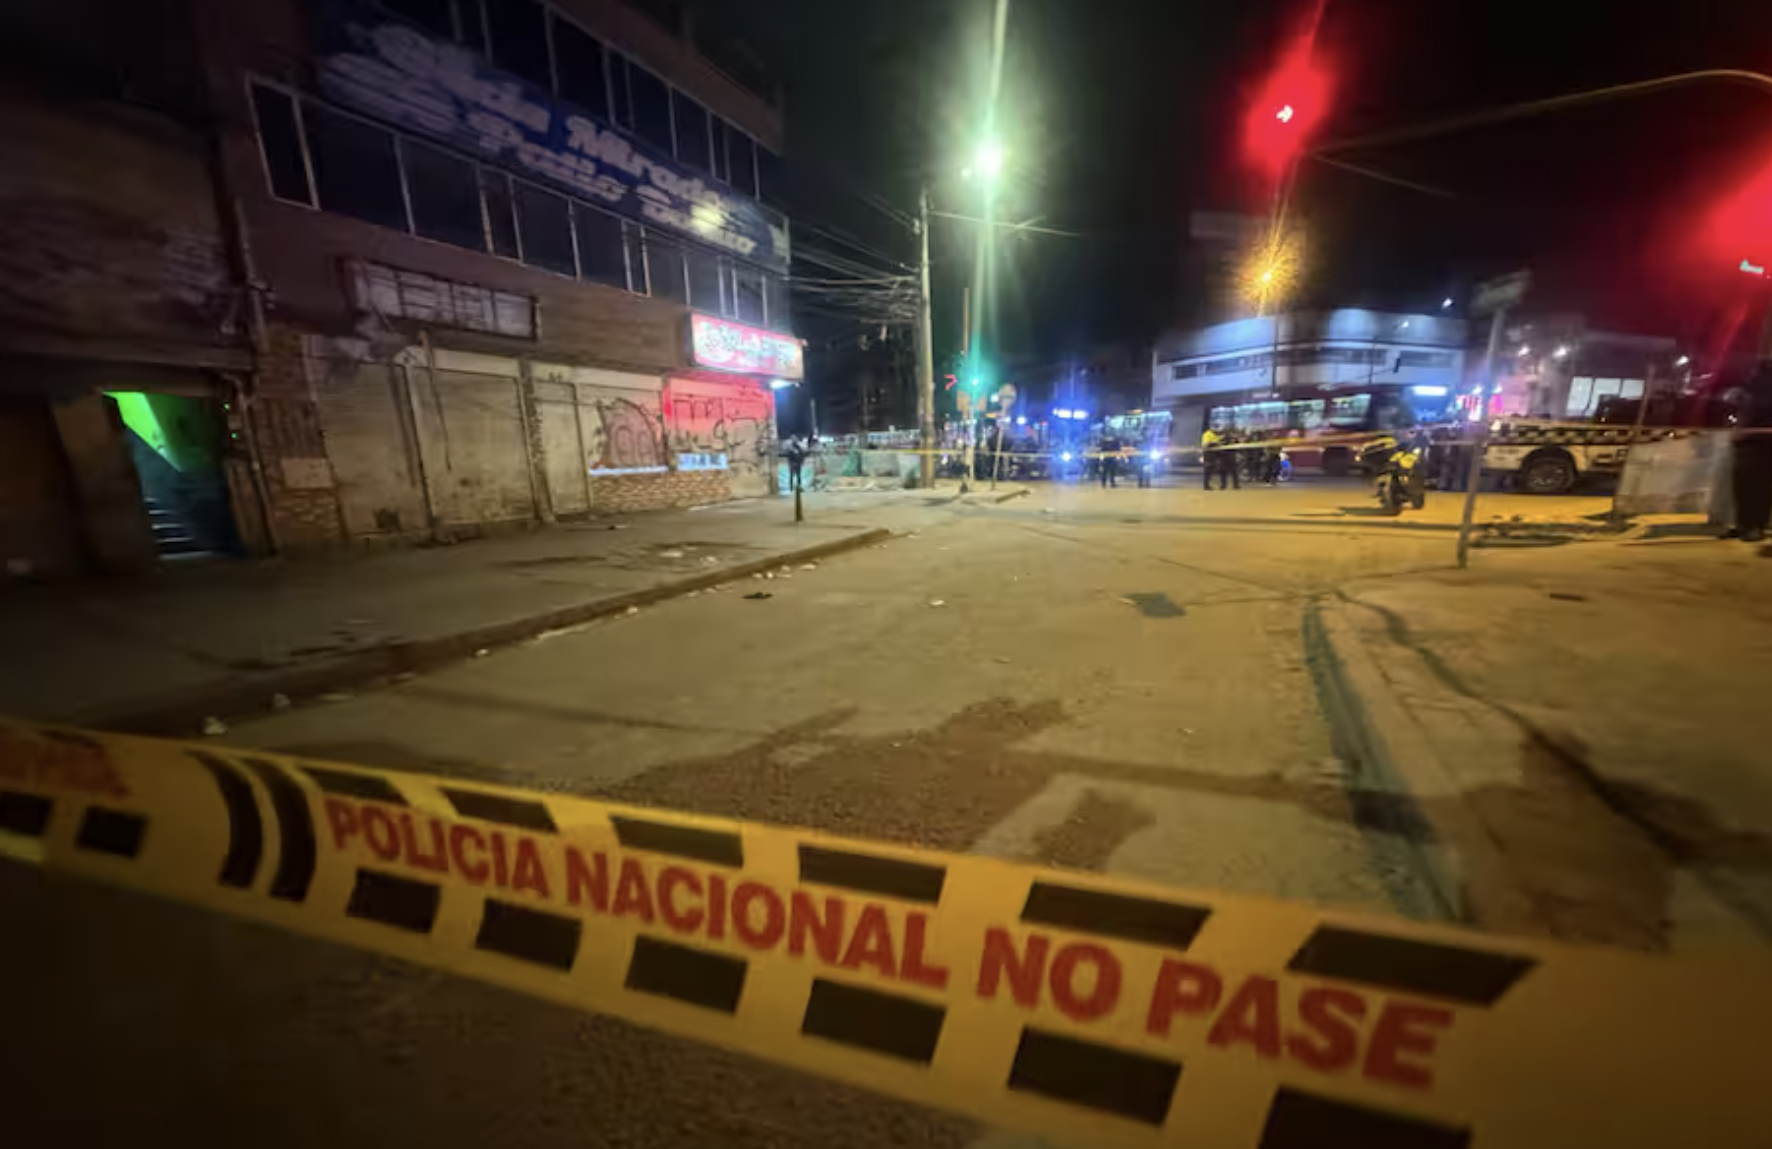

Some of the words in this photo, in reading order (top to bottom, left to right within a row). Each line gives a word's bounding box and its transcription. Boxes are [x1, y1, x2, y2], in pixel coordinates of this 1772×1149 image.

[324, 798, 549, 898] POLICIA
[565, 846, 949, 989] NACIONAL
[977, 926, 1122, 1022] NO
[1146, 957, 1454, 1091] PASE
